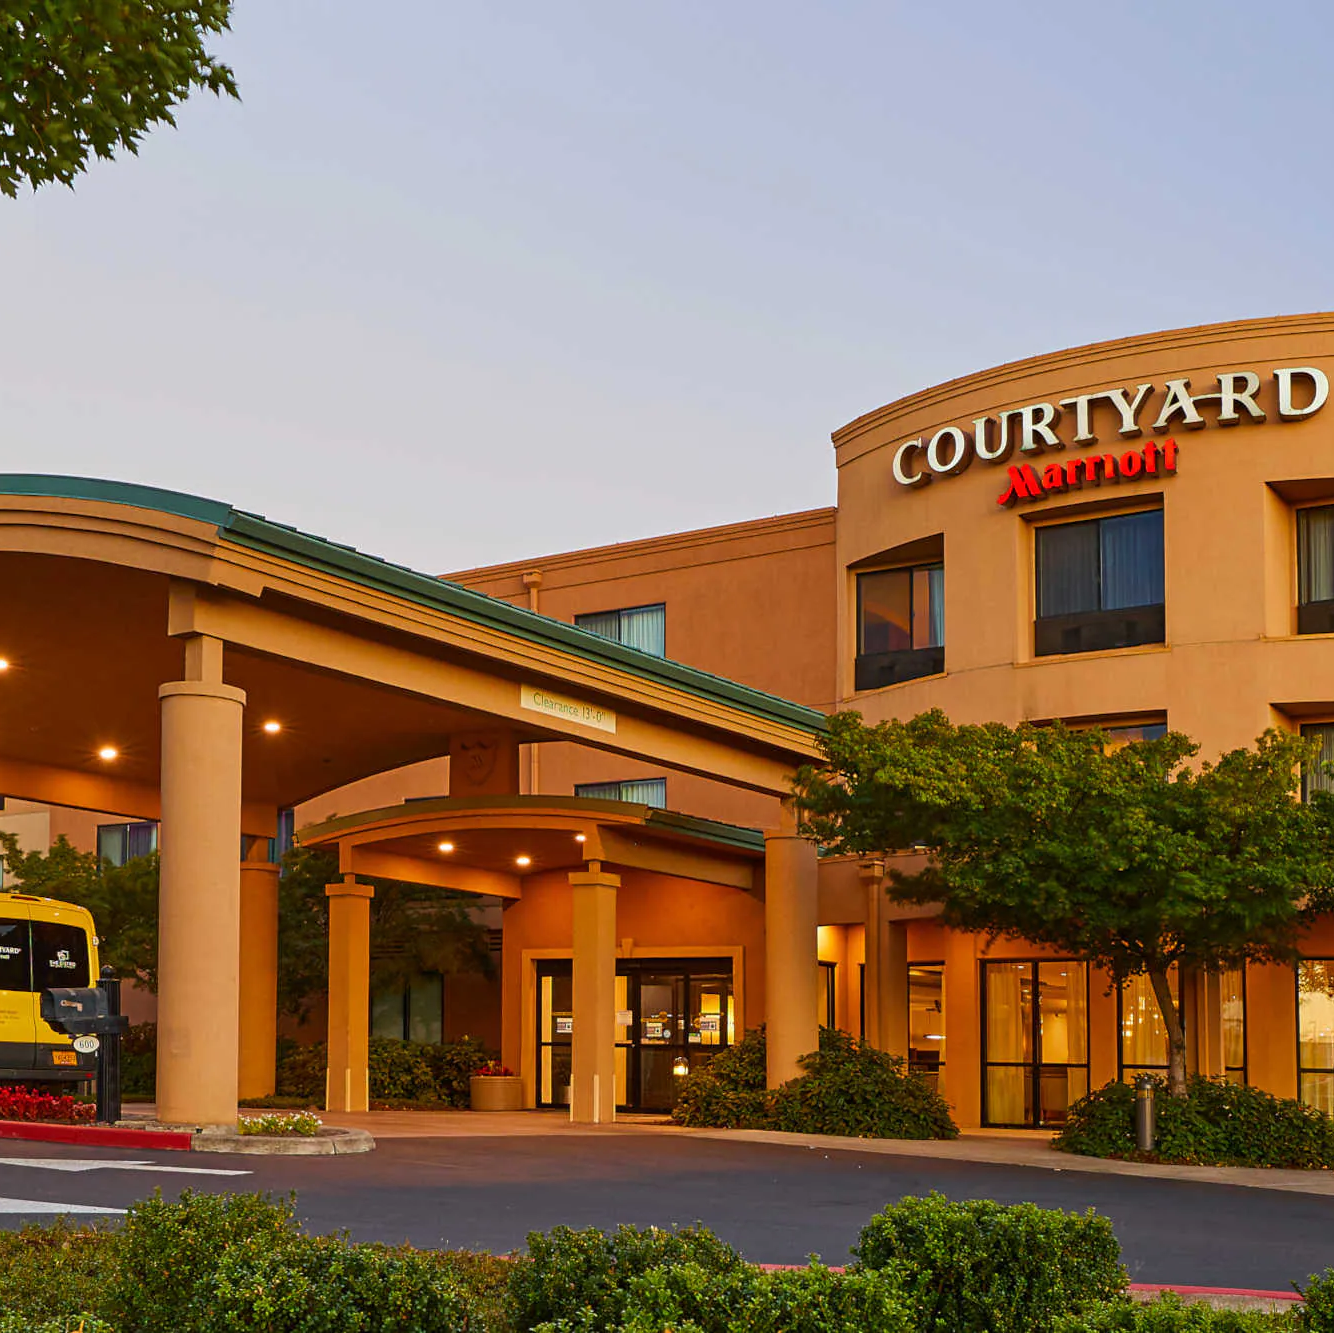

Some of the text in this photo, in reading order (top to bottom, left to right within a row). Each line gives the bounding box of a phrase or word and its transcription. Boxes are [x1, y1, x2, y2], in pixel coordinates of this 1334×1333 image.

[892, 366, 1331, 488] COURTYARD
[997, 437, 1180, 507] Marriott
[533, 691, 579, 716] Clearance
[79, 1039, 95, 1049] 600
